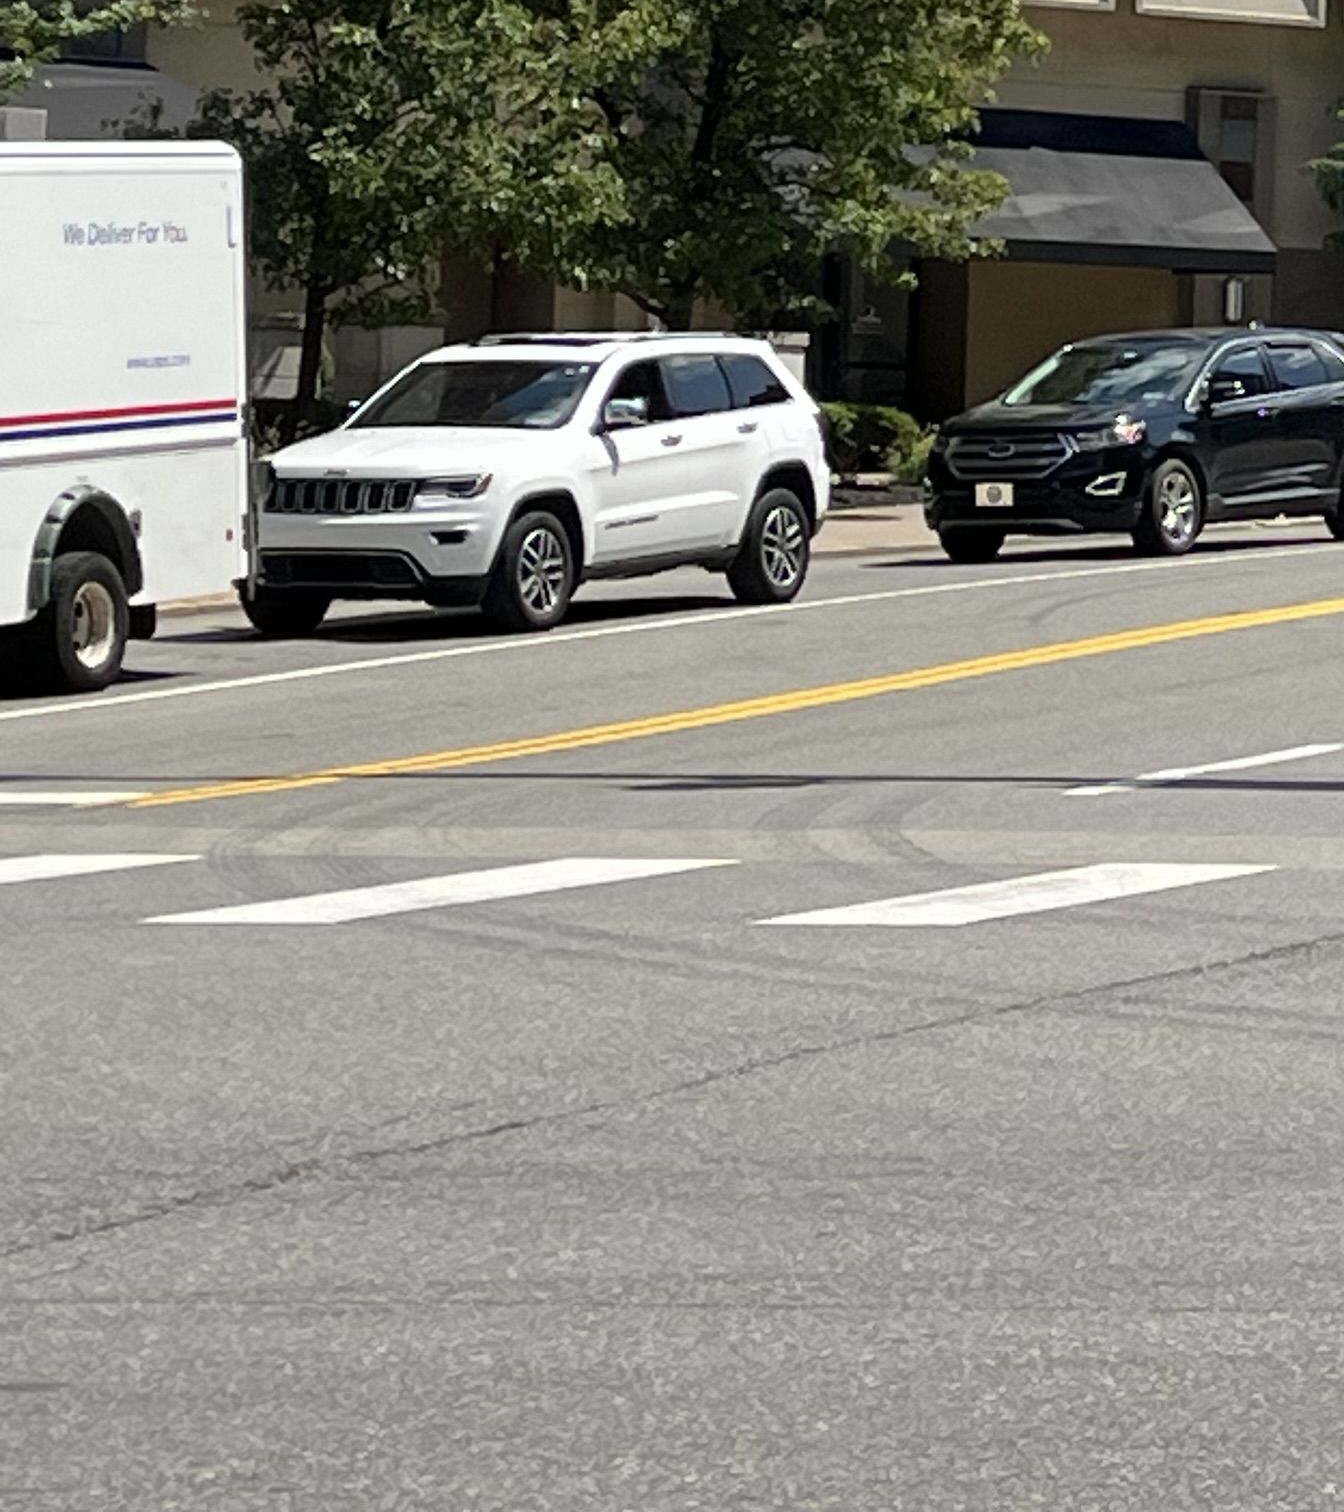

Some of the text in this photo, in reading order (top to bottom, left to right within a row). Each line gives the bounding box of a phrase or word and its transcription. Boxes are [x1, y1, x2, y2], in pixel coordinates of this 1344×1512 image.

[62, 220, 188, 246] We Deliver For You
